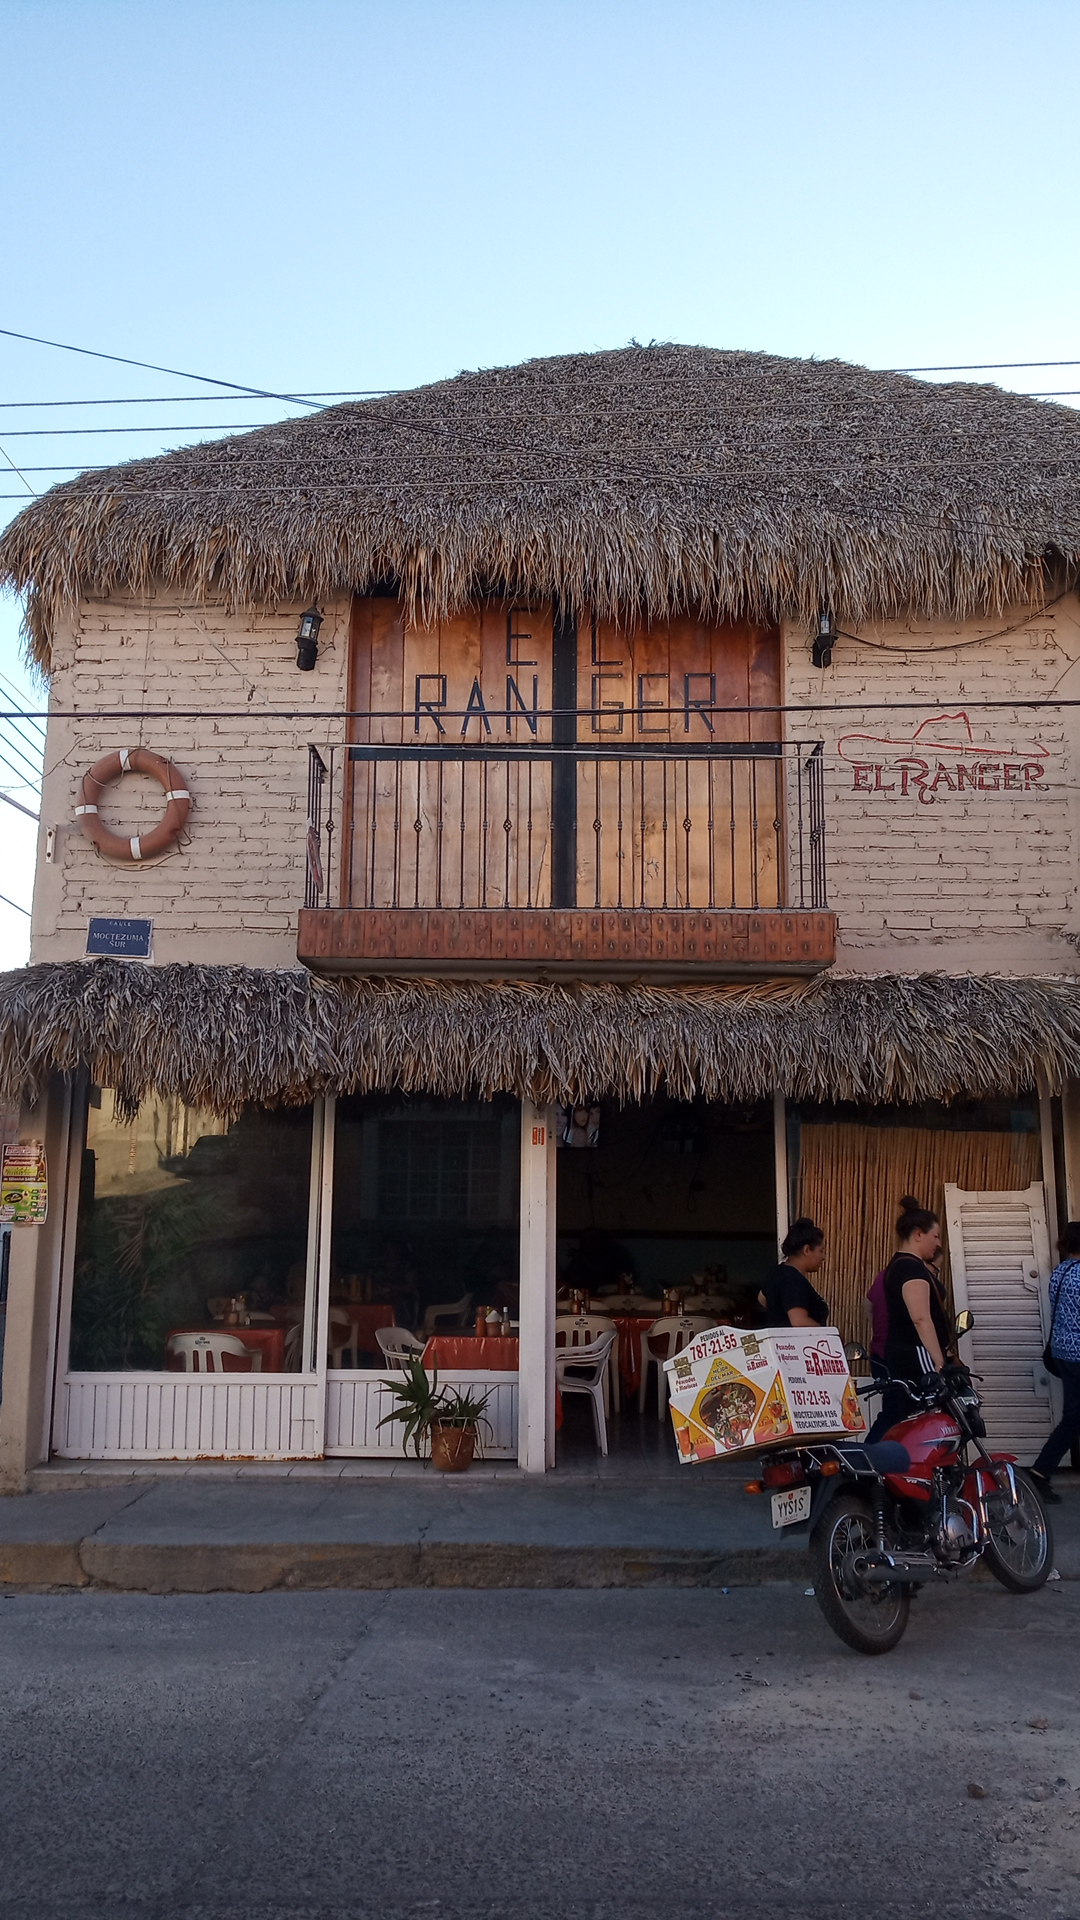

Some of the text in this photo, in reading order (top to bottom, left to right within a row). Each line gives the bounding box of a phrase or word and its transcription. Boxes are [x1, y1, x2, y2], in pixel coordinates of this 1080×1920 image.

[414, 672, 717, 735] RANGER
[851, 757, 1050, 804] EL RANGER
[93, 932, 144, 941] MOCTEZUMA
[700, 1331, 719, 1342] PEDIDOS
[690, 1334, 738, 1360] 787-21-55
[805, 1352, 847, 1376] EL RANGER
[713, 1366, 729, 1374] MEJOR
[710, 1374, 721, 1382] DEL
[721, 1370, 734, 1378] MAR
[788, 1376, 803, 1384] PEDIDOS
[791, 1390, 831, 1406] 787-21-55
[793, 1411, 824, 1419] MOCTEZUMA
[824, 1410, 838, 1418] #196
[795, 1420, 841, 1429] TEOCALTICHE, JAL.
